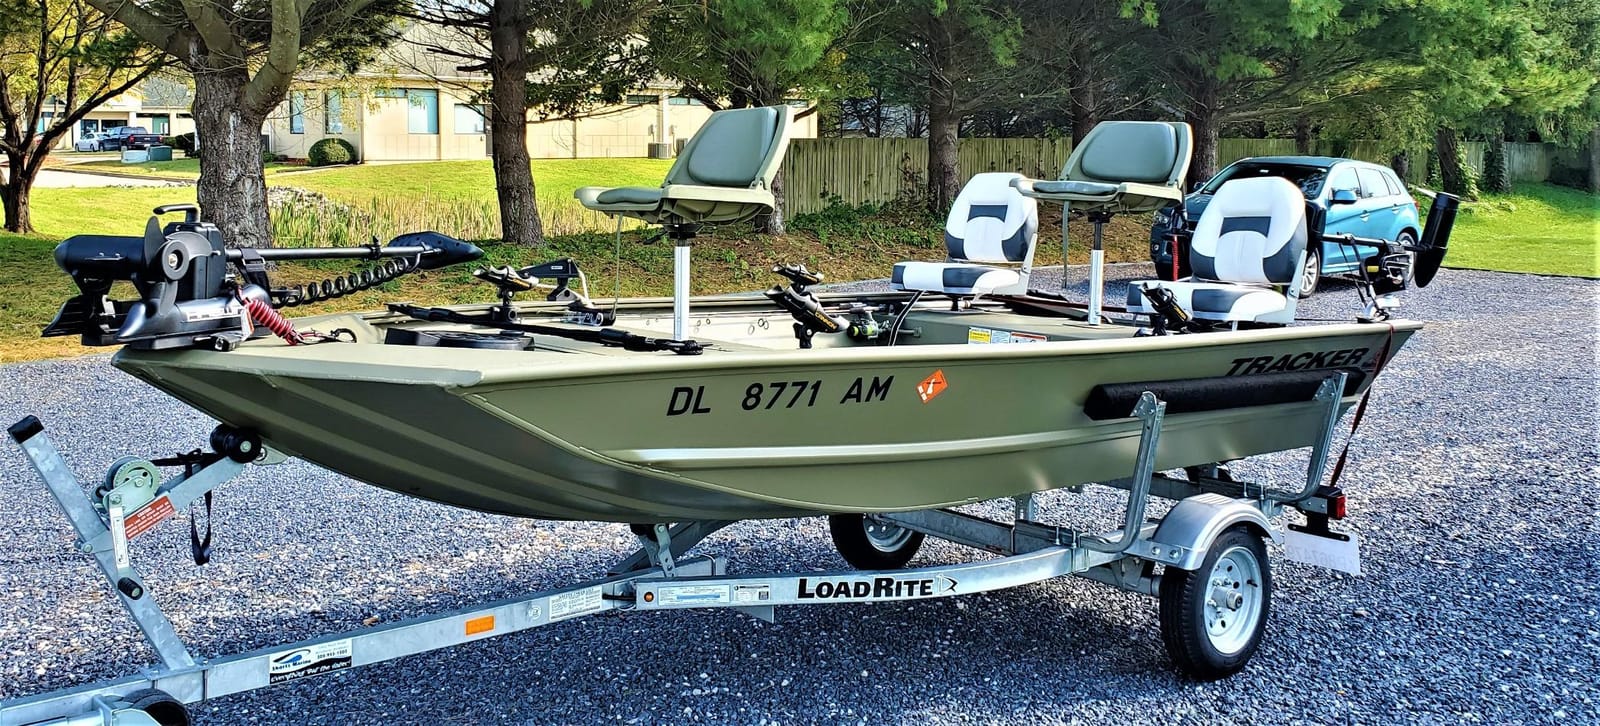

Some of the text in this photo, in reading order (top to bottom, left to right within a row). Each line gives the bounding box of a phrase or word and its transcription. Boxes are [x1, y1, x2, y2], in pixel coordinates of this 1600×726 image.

[1225, 347, 1370, 377] TRACKER
[666, 375, 894, 416] DL 8771 AM
